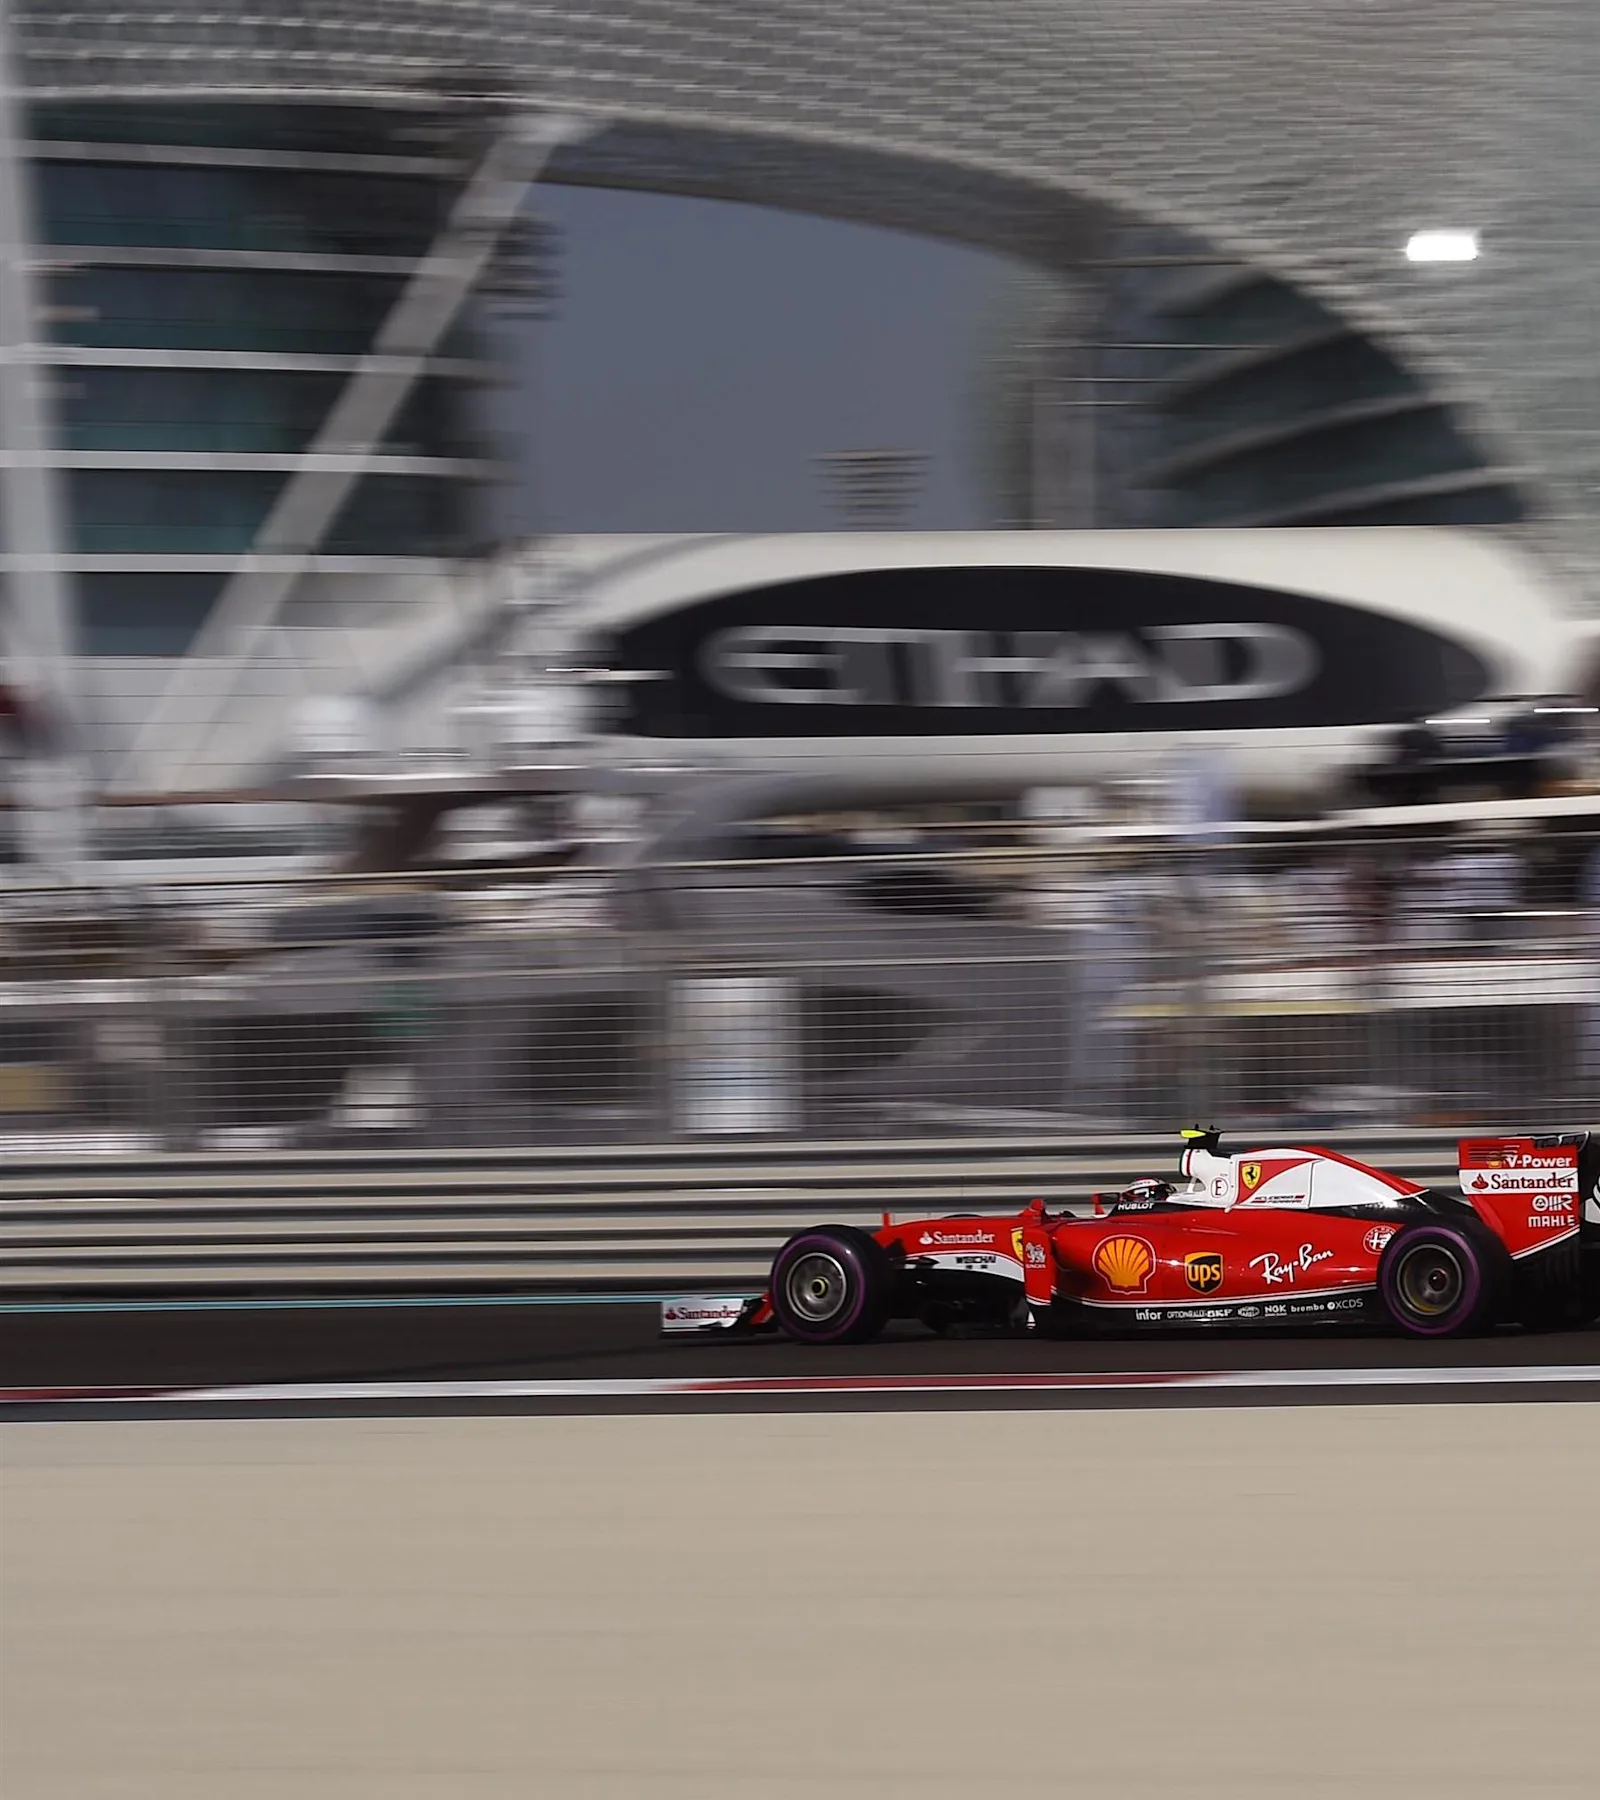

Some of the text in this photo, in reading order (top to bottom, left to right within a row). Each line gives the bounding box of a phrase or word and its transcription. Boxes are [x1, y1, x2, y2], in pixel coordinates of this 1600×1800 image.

[698, 622, 1320, 708] ETIHAD
[1506, 1155, 1573, 1168] V-Power
[1491, 1172, 1574, 1190] Santander
[1117, 1202, 1155, 1211] HUBLOT
[1528, 1215, 1575, 1228] MAHLE
[933, 1229, 995, 1245] Santander
[1188, 1263, 1220, 1288] ups
[1135, 1309, 1162, 1320] infor
[1291, 1303, 1325, 1313] brembo
